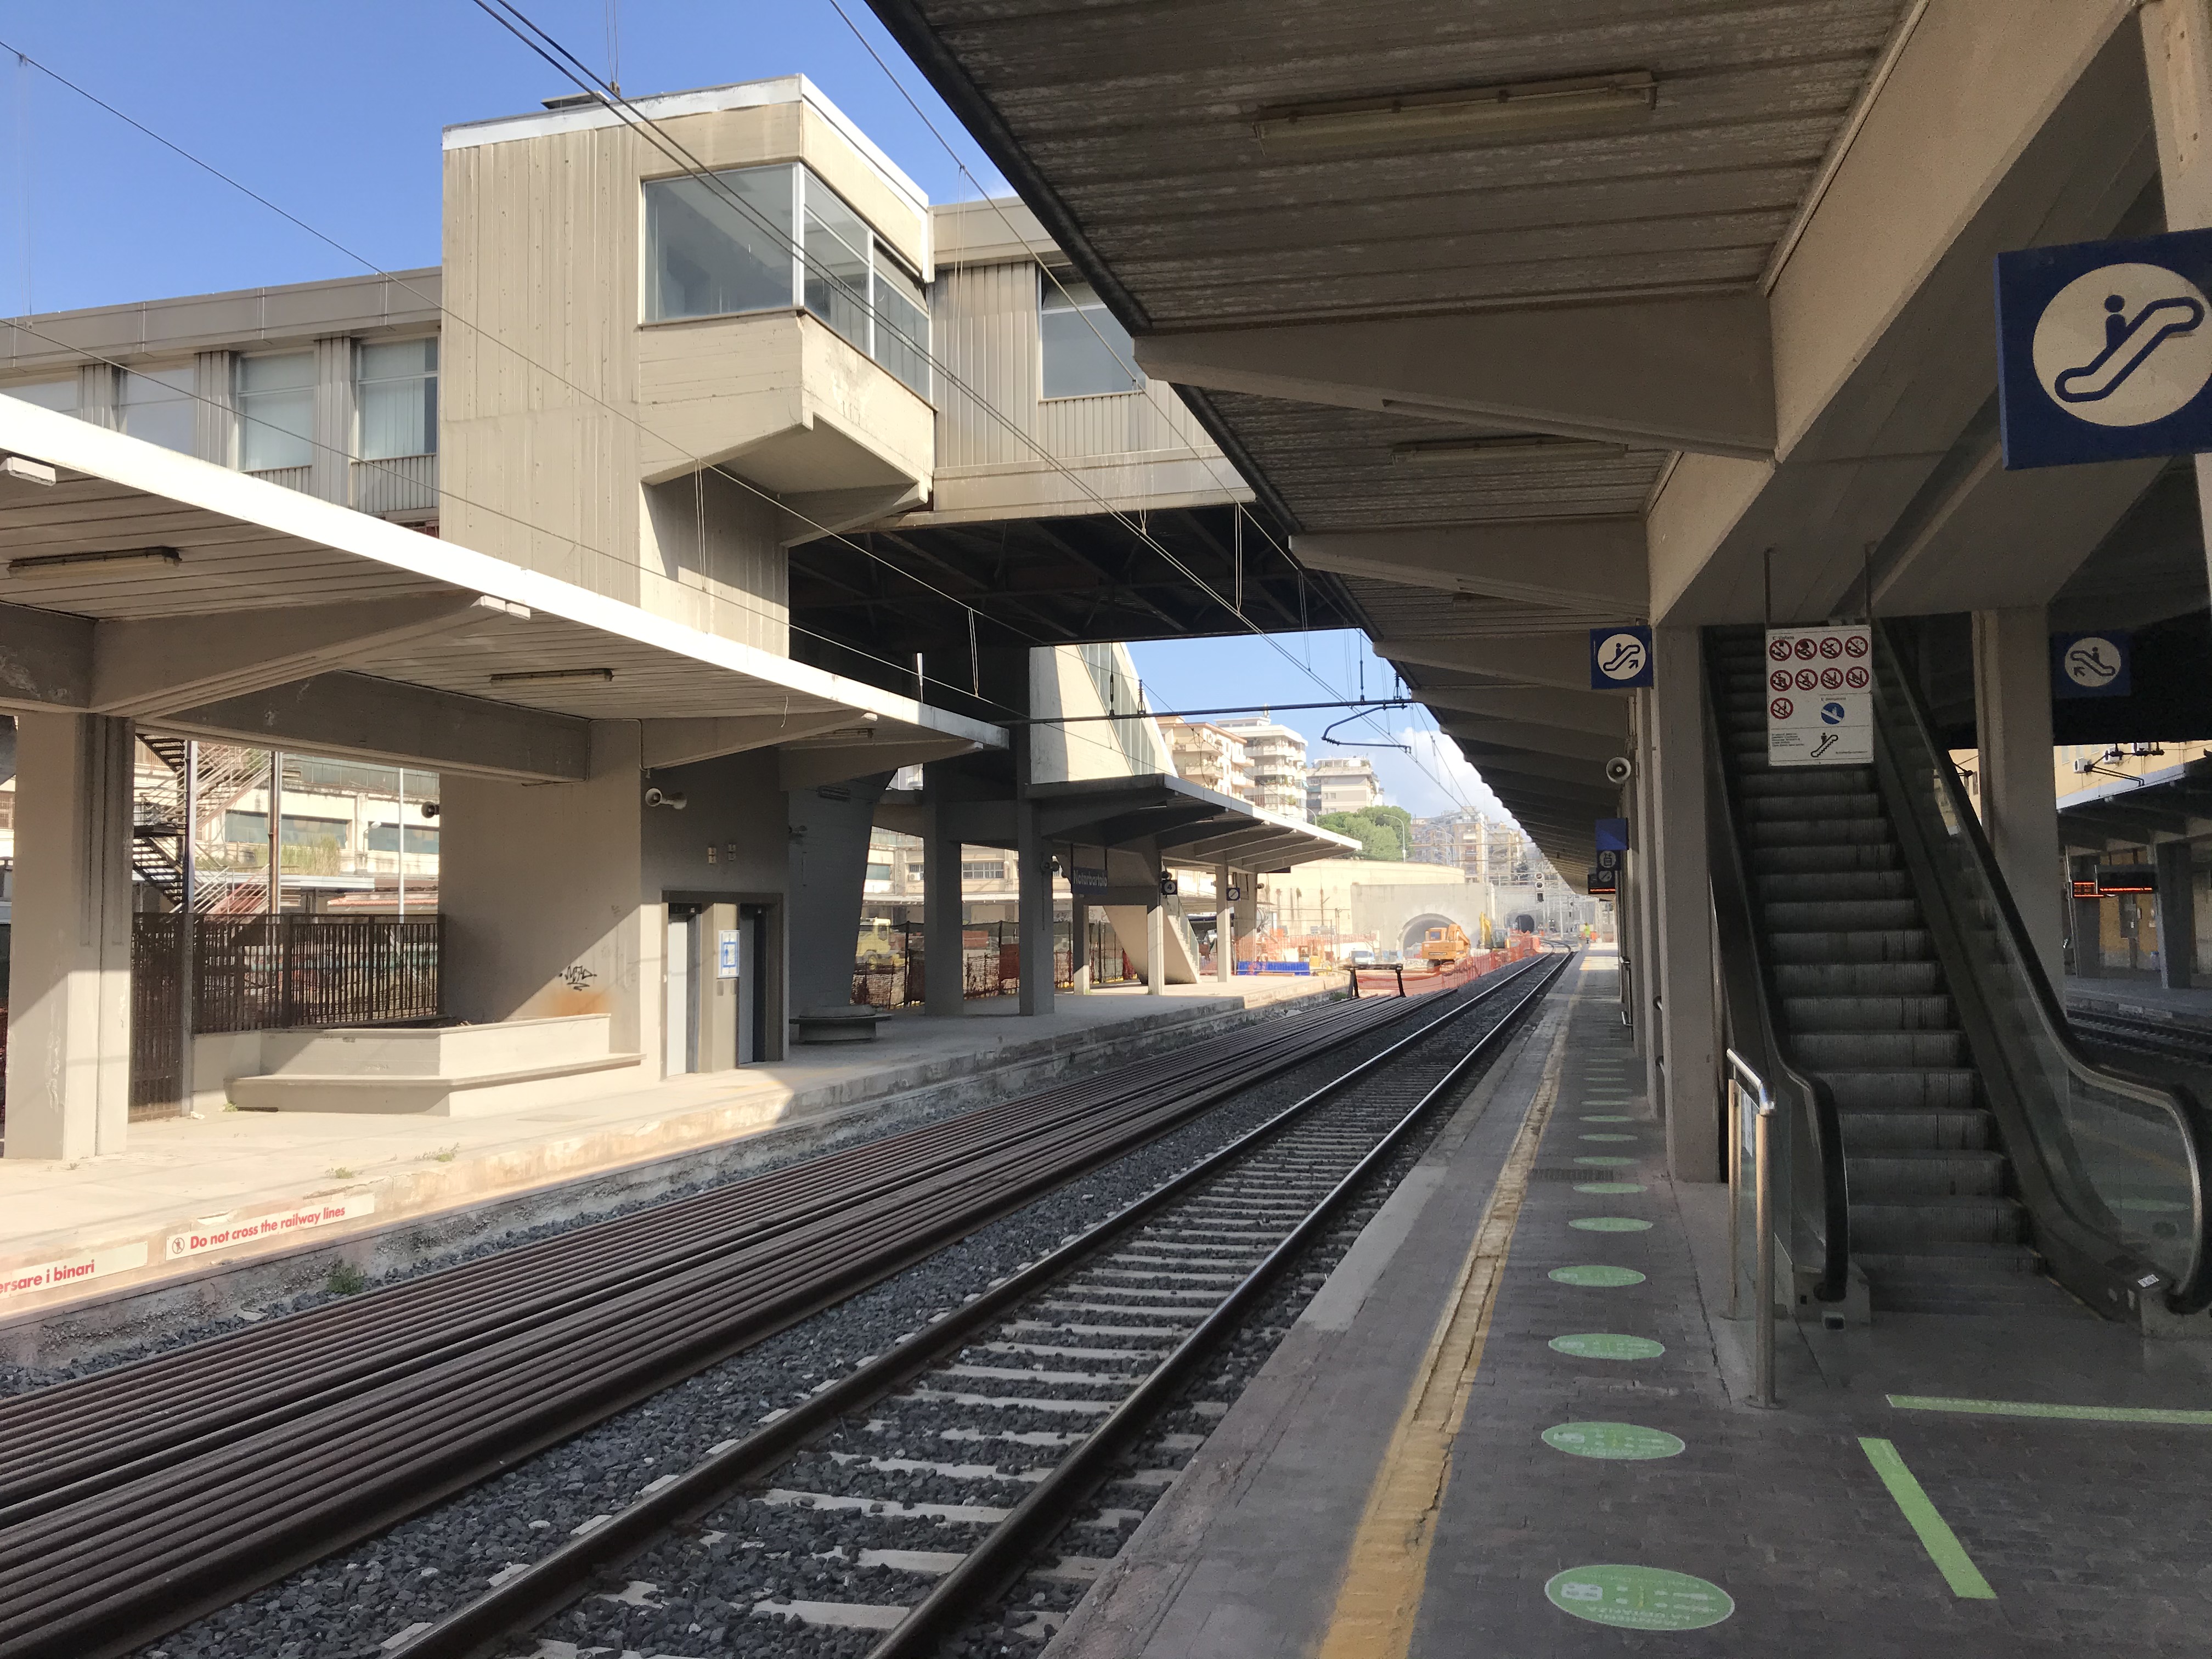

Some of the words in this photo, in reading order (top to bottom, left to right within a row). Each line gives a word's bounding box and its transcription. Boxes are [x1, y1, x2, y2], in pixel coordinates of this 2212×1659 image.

[1073, 870, 1107, 887] Notarbartolo
[190, 1235, 207, 1249] Do
[210, 1230, 229, 1245] not
[232, 1226, 258, 1240] cross
[261, 1219, 278, 1233] the
[280, 1212, 321, 1229] railway
[323, 1207, 345, 1220] lines
[46, 1268, 50, 1283] i
[54, 1259, 95, 1282] binari
